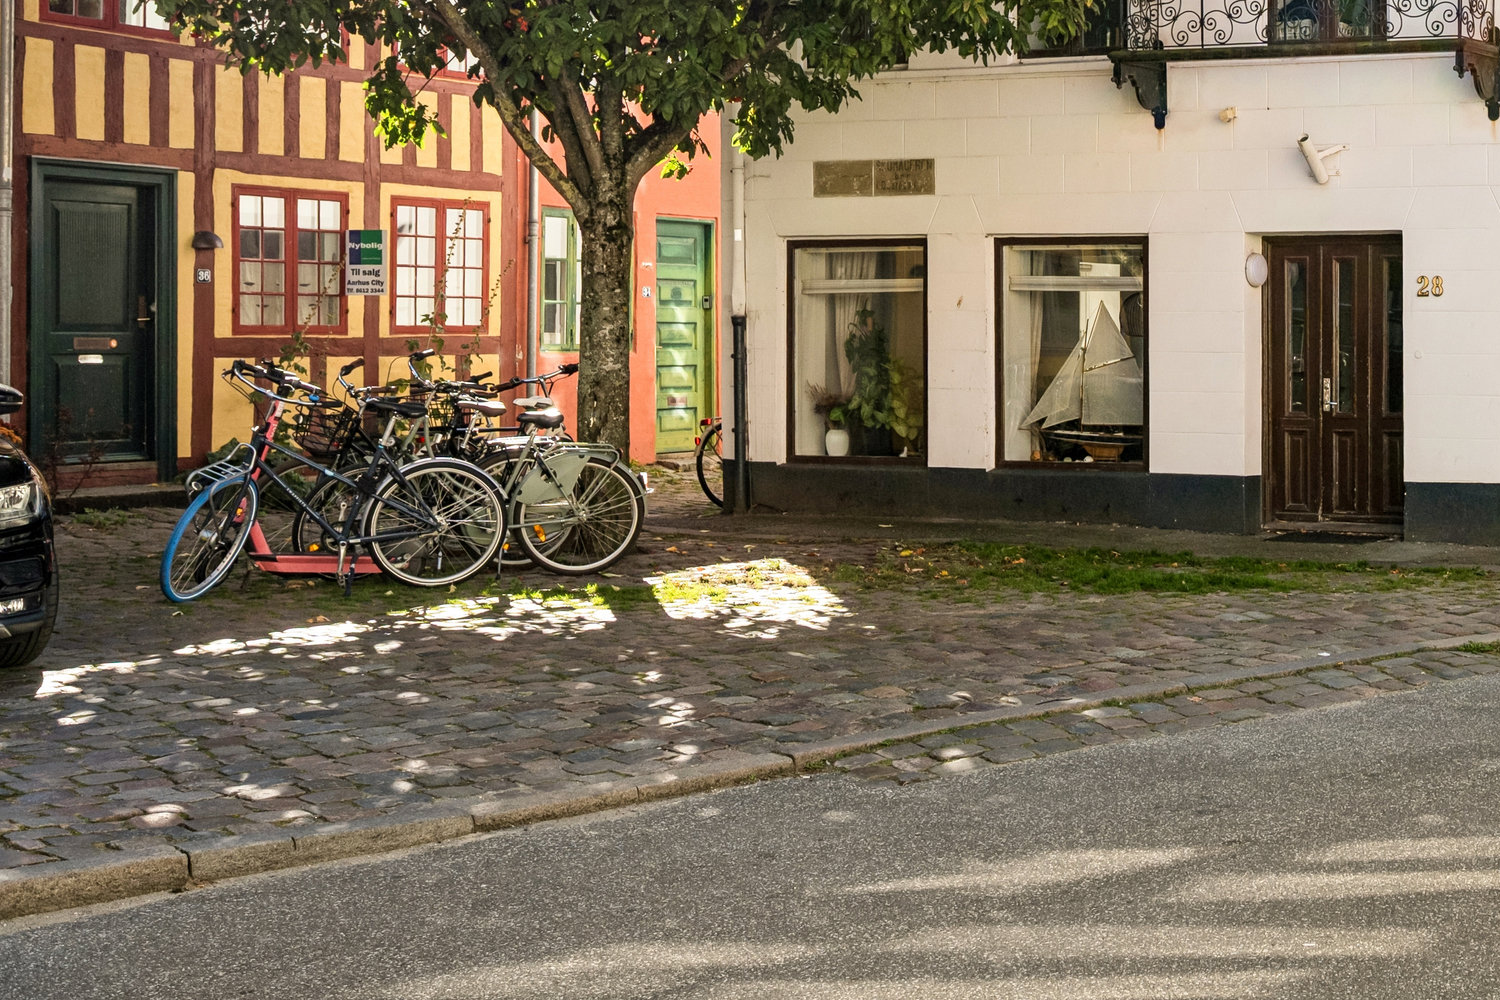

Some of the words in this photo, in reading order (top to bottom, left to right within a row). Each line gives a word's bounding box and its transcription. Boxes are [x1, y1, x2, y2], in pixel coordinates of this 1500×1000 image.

[348, 242, 382, 250] Nybolig
[362, 269, 381, 277] salg
[1416, 275, 1444, 297] 28
